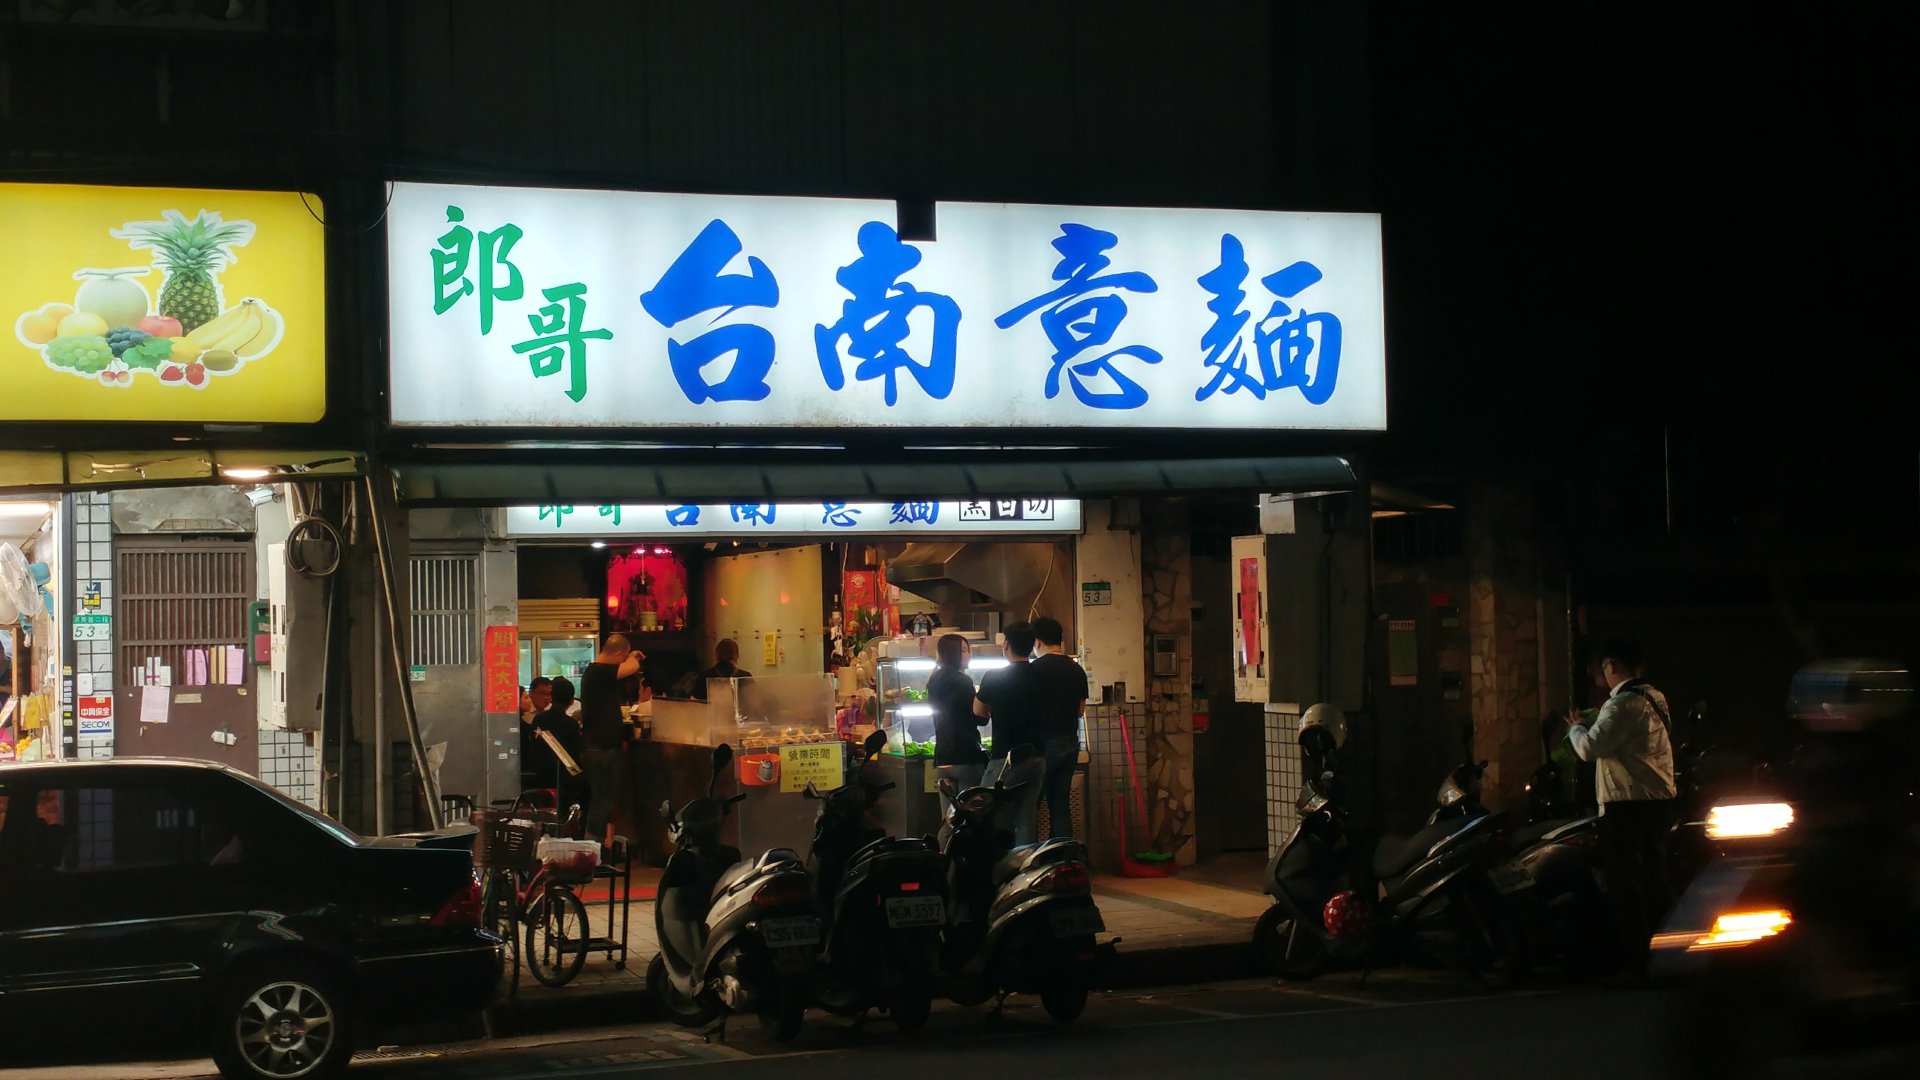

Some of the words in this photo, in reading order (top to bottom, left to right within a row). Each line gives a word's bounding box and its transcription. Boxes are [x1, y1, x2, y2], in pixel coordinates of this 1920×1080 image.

[430, 206, 613, 402] 郎哥
[640, 218, 1343, 410] 台南意麵
[75, 625, 96, 638] 53
[81, 720, 110, 729] SECOM
